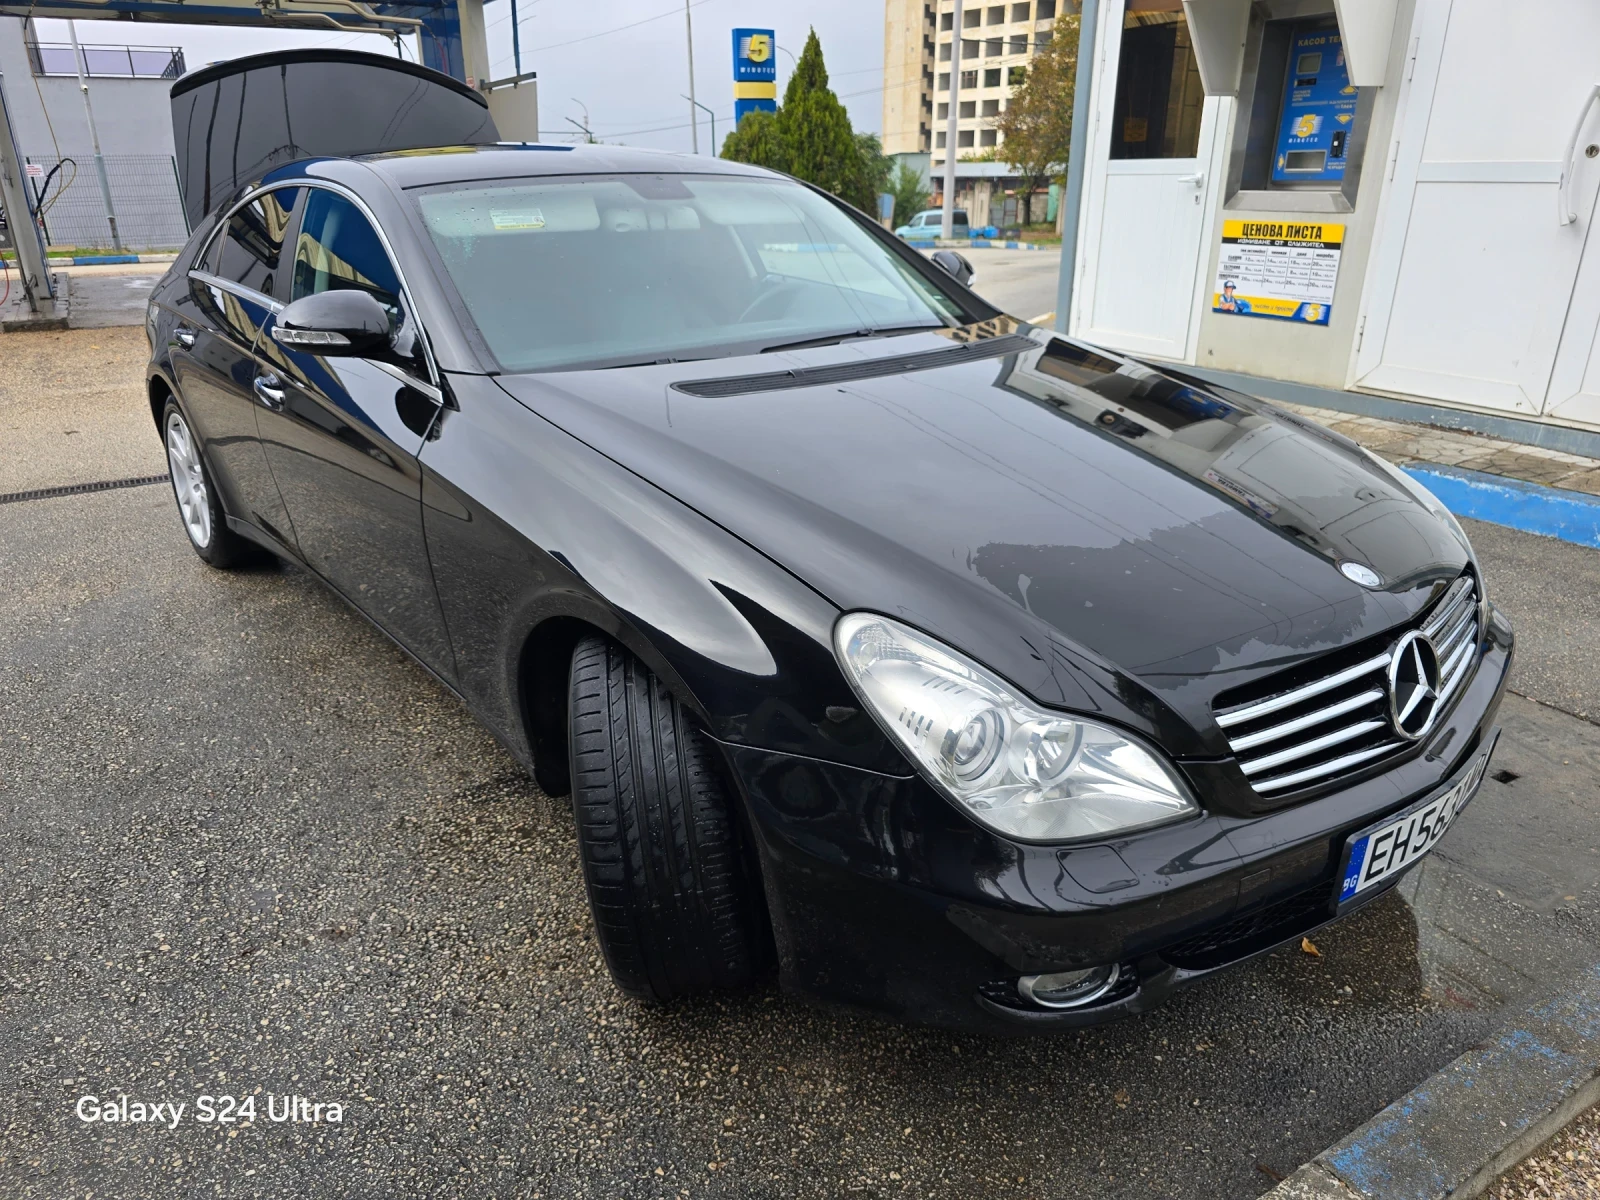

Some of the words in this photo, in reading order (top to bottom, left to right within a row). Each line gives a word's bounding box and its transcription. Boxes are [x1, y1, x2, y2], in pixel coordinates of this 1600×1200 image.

[747, 33, 770, 63] 5
[1298, 37, 1326, 46] КАСОВ
[1296, 114, 1317, 138] 5
[1242, 223, 1283, 238] ЦЕНОВА
[1285, 225, 1322, 239] ЛИСТА
[1305, 302, 1321, 322] 5
[1343, 874, 1358, 892] BG
